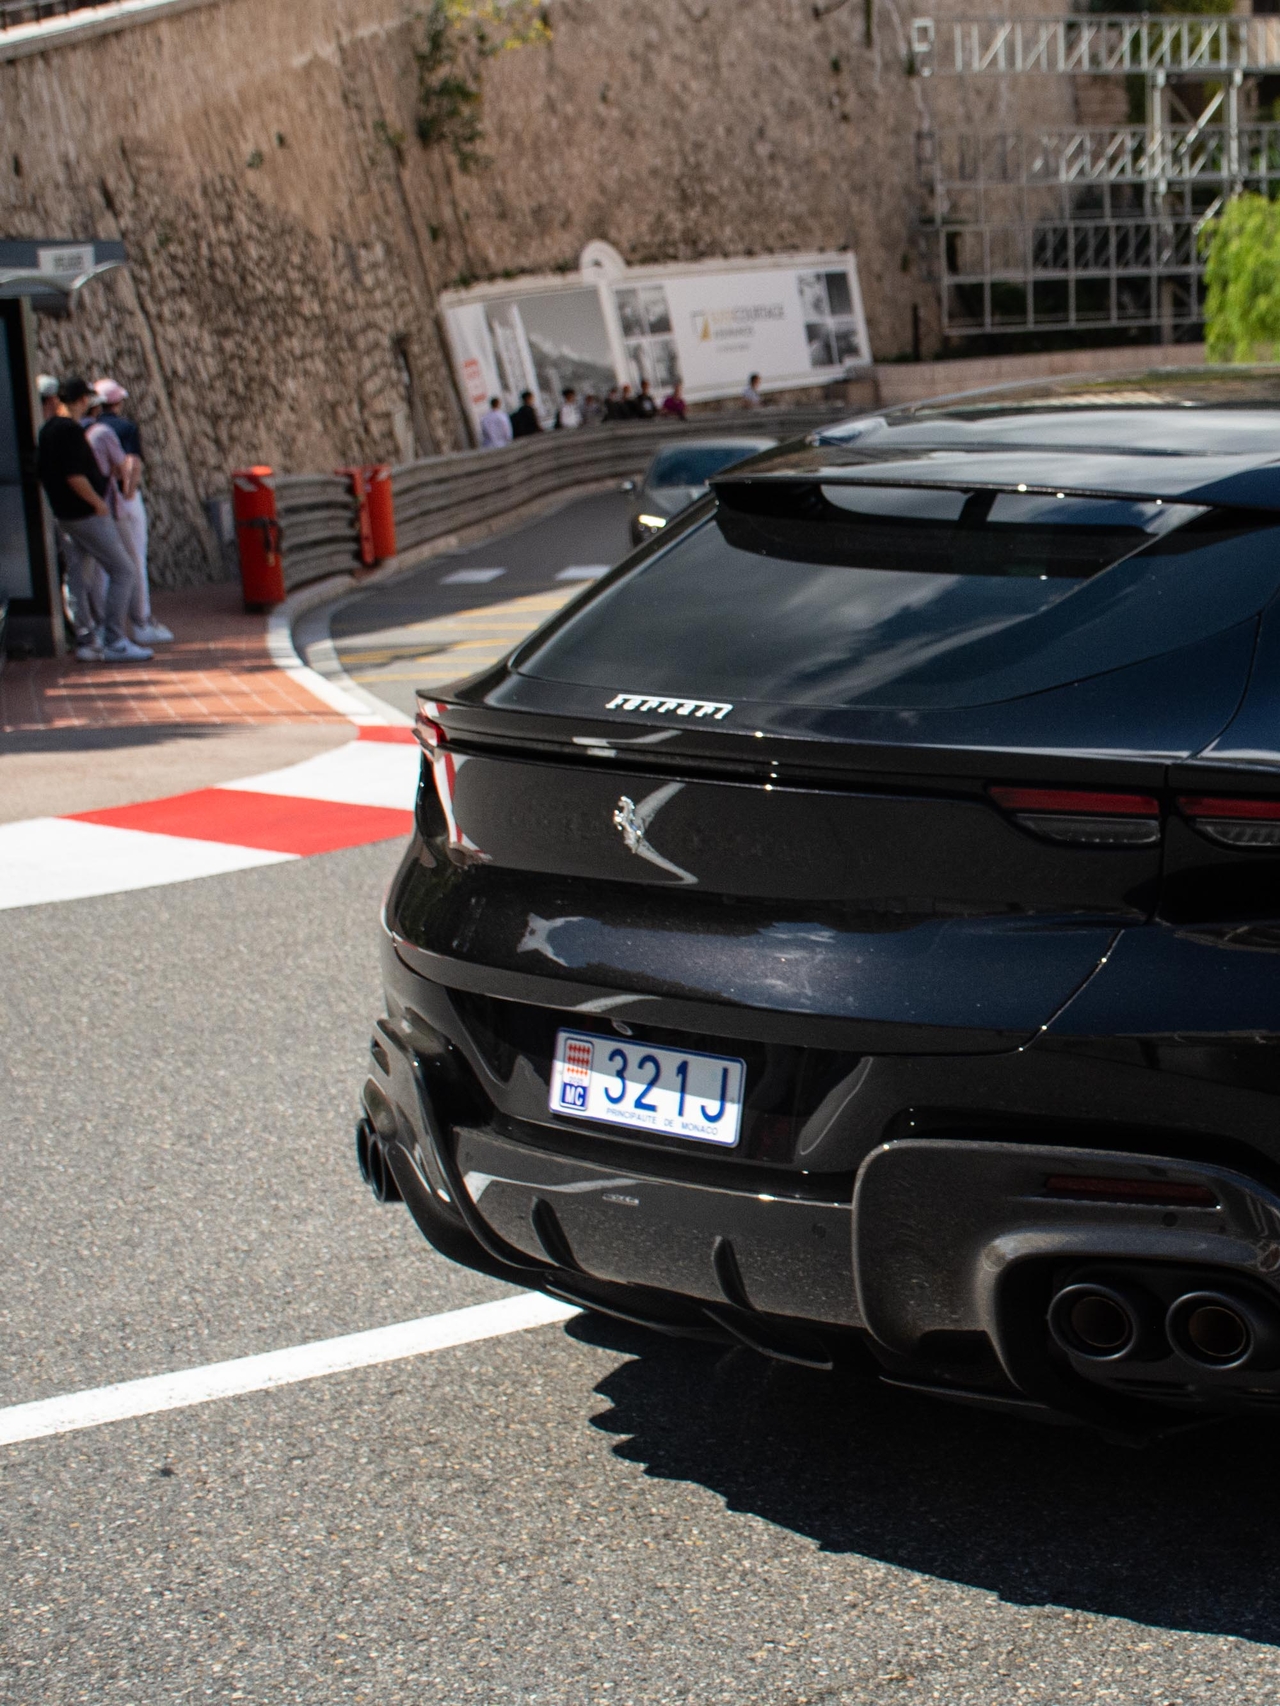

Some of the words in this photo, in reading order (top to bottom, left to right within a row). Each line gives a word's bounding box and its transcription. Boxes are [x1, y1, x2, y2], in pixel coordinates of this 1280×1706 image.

[564, 1084, 584, 1106] MC
[604, 1048, 729, 1122] 321J
[664, 1118, 674, 1128] DE
[682, 1121, 718, 1136] MONACO
